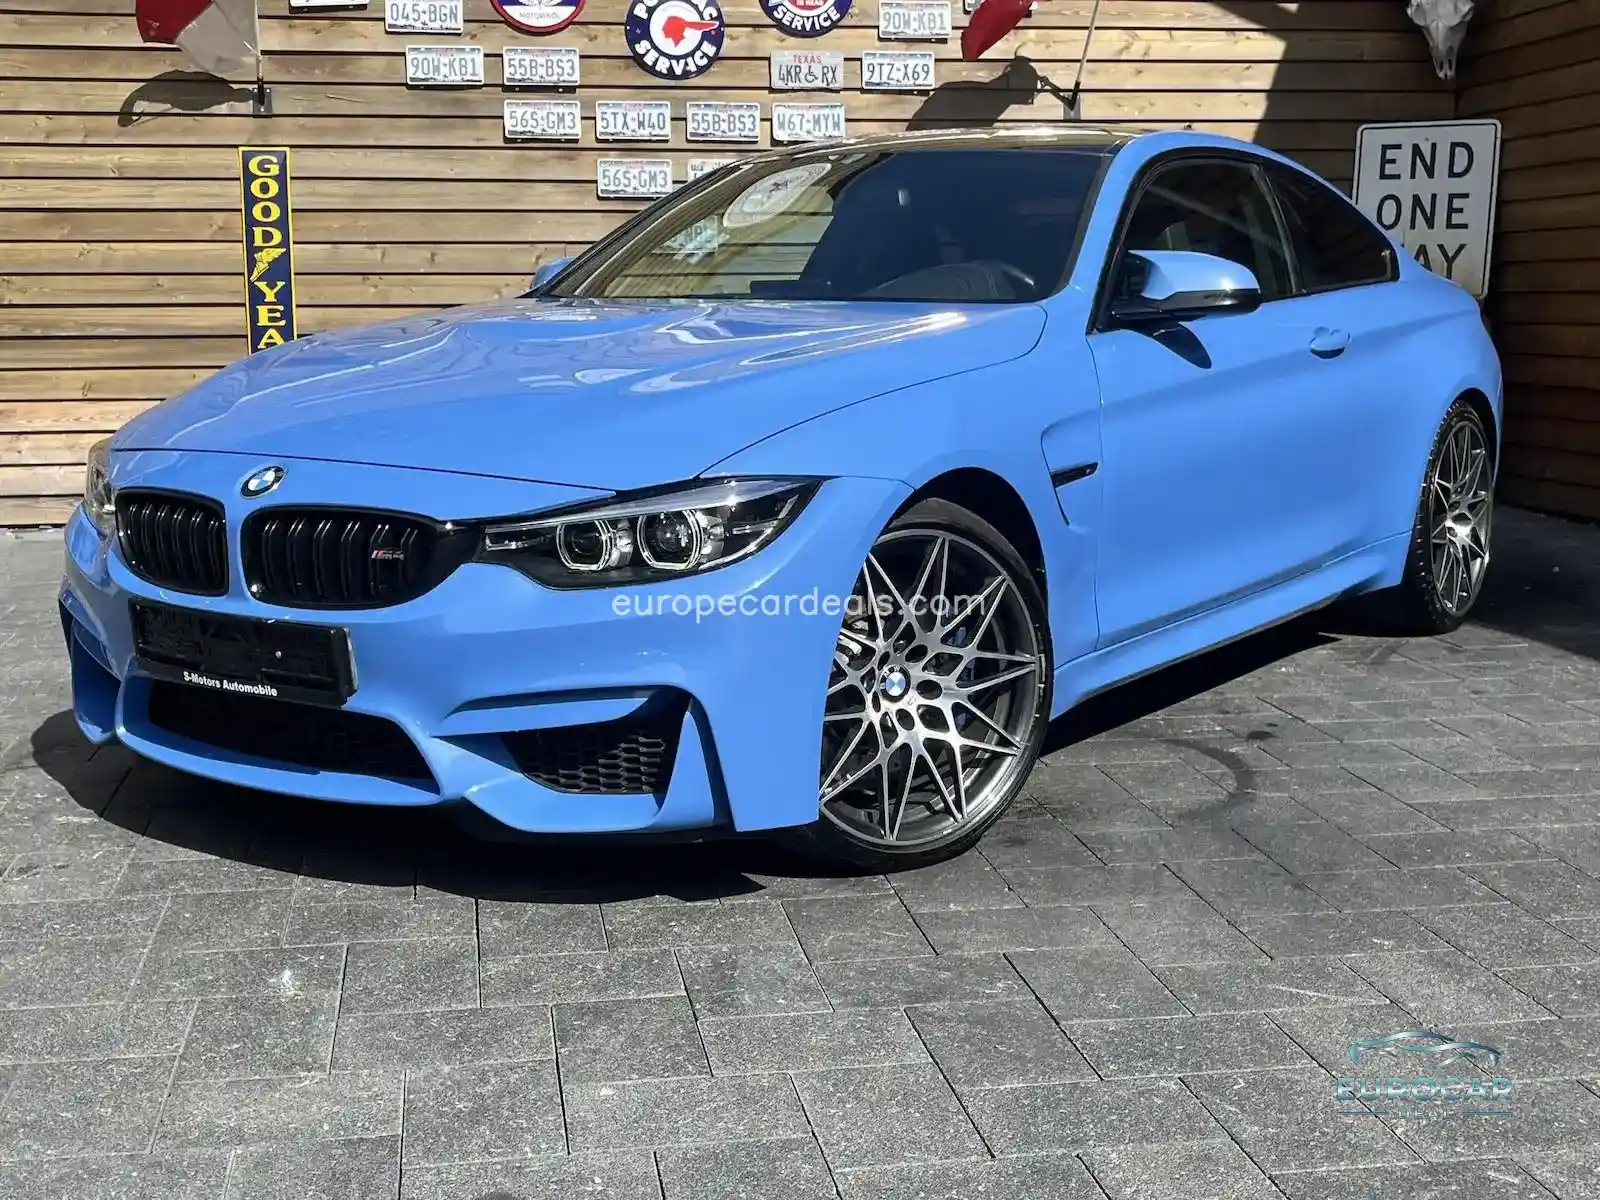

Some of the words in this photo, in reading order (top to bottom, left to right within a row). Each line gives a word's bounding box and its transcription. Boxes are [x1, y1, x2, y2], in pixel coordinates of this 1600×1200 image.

[773, 5, 841, 32] SERVICE
[634, 40, 717, 76] SERVICE
[793, 54, 822, 64] TEXAS
[1378, 141, 1474, 180] END
[248, 155, 283, 247] GOOD
[1376, 193, 1470, 230] ONE
[1402, 243, 1467, 280] AY
[253, 281, 287, 349] YEA
[183, 671, 221, 688] S-Motors
[222, 680, 278, 697] Automobile
